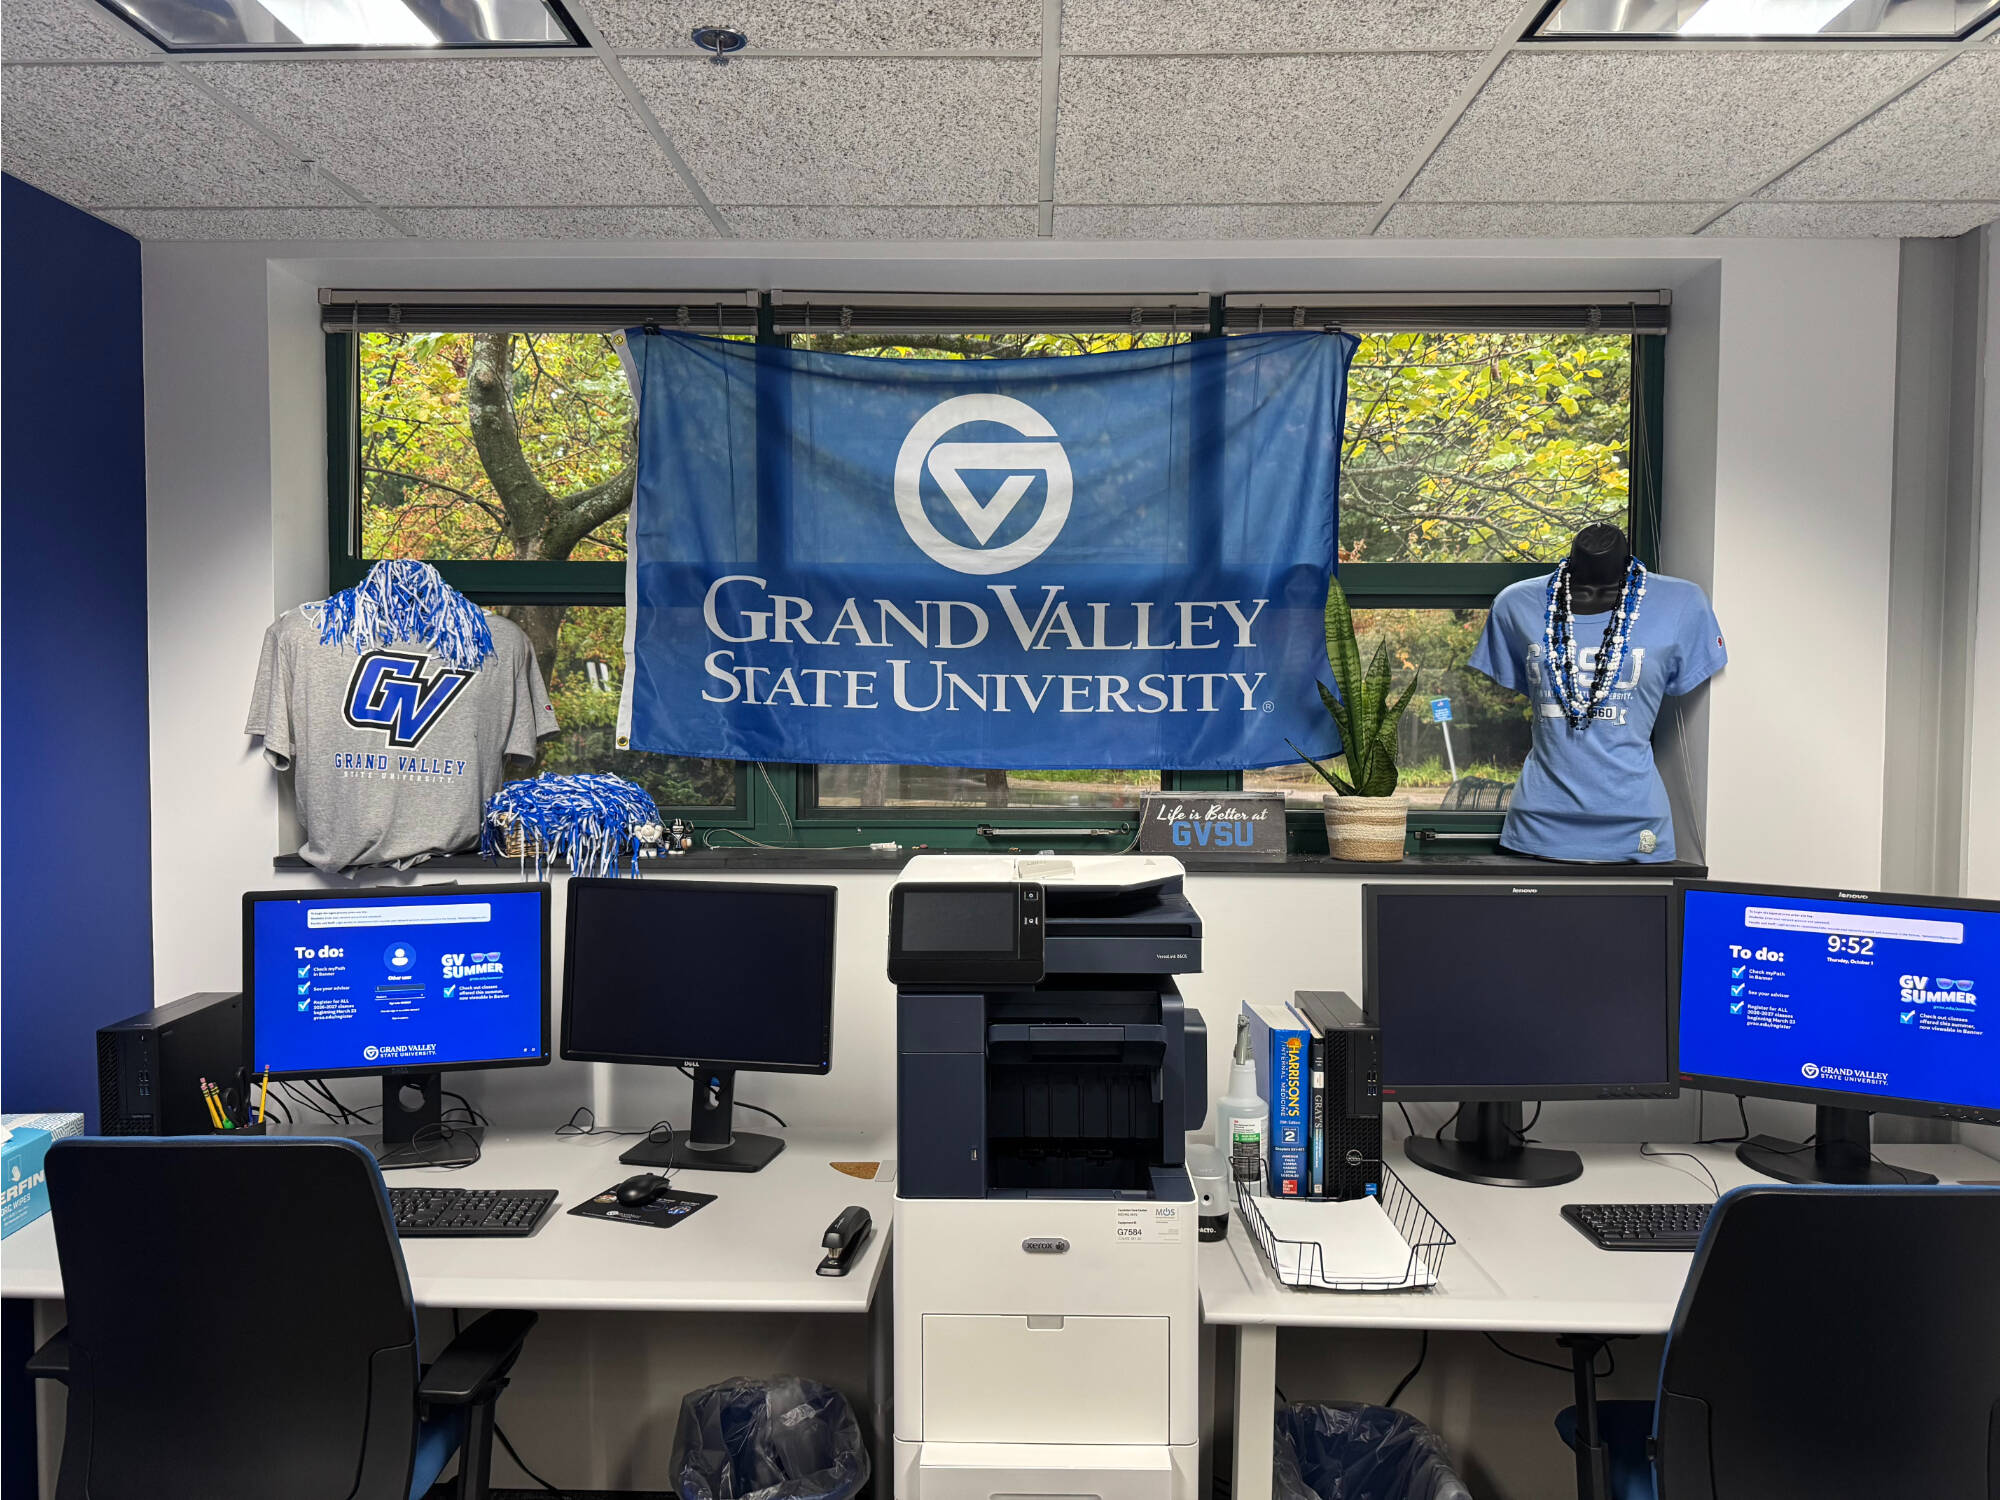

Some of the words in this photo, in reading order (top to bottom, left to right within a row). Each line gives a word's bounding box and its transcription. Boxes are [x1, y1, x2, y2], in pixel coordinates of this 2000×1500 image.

[702, 575, 990, 649] GRAND
[987, 584, 1269, 651] VALLEY
[1527, 643, 1646, 690] GSU
[701, 649, 878, 709] STATE
[342, 650, 478, 750] GV
[334, 753, 388, 771] GRAND
[398, 756, 466, 776] VALLEY
[1156, 804, 1186, 826] Life
[1187, 809, 1202, 820] is
[1205, 804, 1249, 821] Better
[1251, 807, 1269, 821] at
[1172, 821, 1254, 847] GVSU
[1838, 891, 1869, 900] lenovo
[294, 946, 315, 959] To
[318, 944, 344, 958] do:
[1729, 944, 1752, 959] To
[1755, 946, 1784, 963] do:
[1827, 935, 1874, 956] 9:52
[441, 953, 465, 967] GV
[1850, 958, 1871, 966] October
[442, 962, 504, 979] SUMMER
[1899, 974, 1929, 990] GV
[1900, 988, 1977, 1006] SUMMER
[380, 1045, 408, 1053] GRAND
[408, 1043, 437, 1051] VALLEY
[1288, 1044, 1300, 1117] HARRISON'S
[1820, 1065, 1853, 1076] GRAND
[1854, 1069, 1889, 1080] VALLEY
[1820, 1073, 1842, 1081] STATE
[1314, 1094, 1323, 1128] GRAY'S
[1284, 1130, 1296, 1142] 2
[1117, 1228, 1142, 1236] G7584
